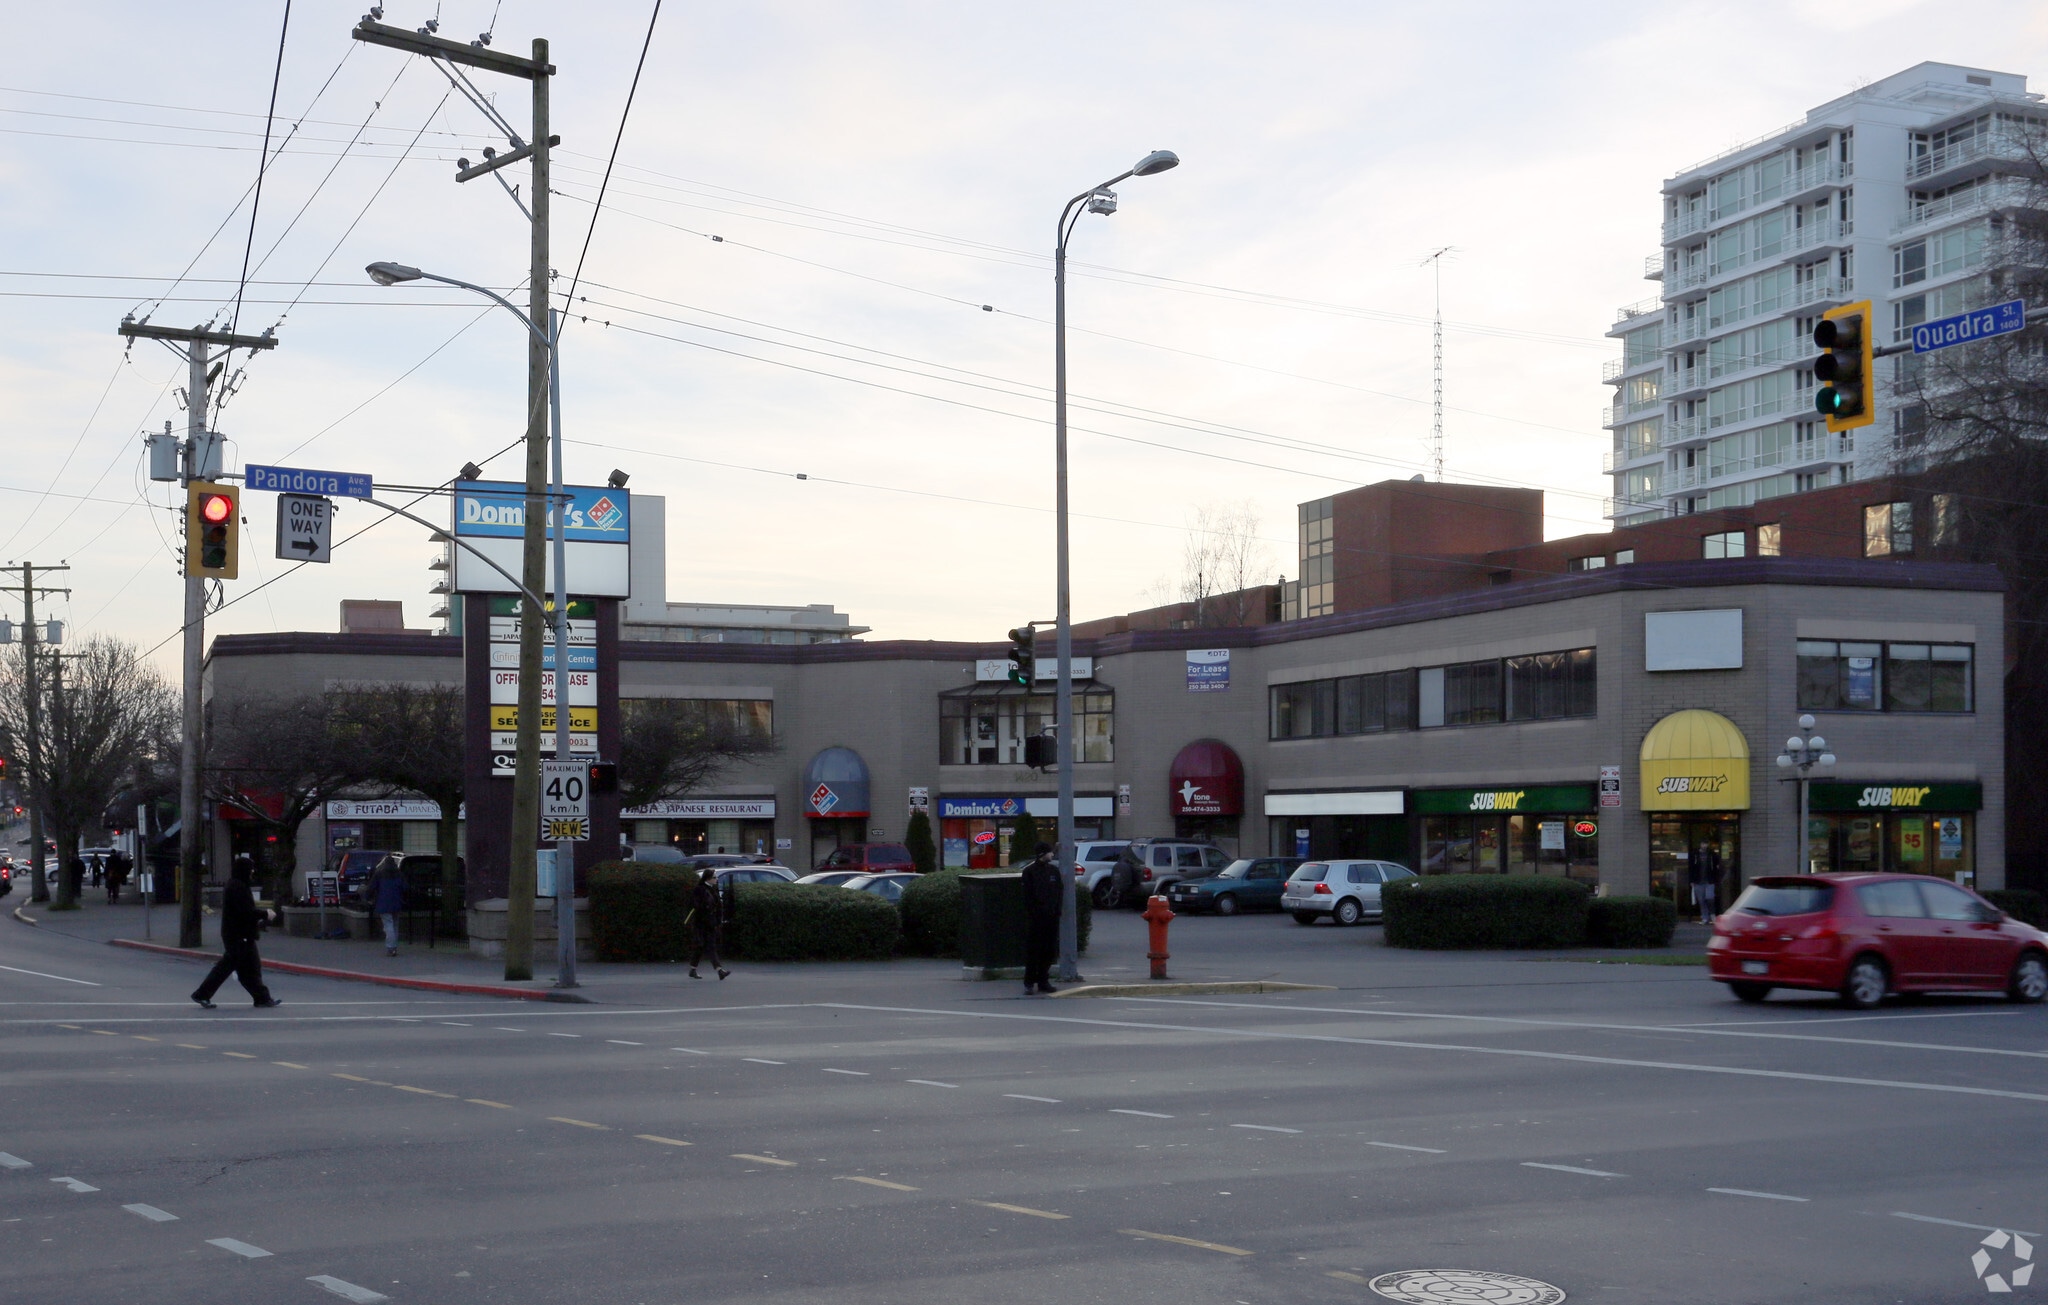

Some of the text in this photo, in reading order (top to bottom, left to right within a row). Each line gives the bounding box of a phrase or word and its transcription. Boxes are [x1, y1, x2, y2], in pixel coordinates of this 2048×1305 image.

[2000, 319, 2020, 331] 1400
[1916, 314, 1995, 350] Quadra
[254, 468, 368, 493] Pandora Ave.
[290, 501, 324, 518] ONE
[290, 518, 322, 534] WAY
[567, 654, 595, 664] Centre
[1187, 665, 1227, 673] For Lease
[546, 765, 584, 773] MAXIMUM
[545, 776, 584, 802] 40
[1657, 773, 1728, 795] SUBWAY
[1470, 789, 1525, 811] SUBWAY
[1857, 786, 1931, 807] SUBWAY
[355, 804, 399, 814] FUTABA
[550, 804, 580, 813] km/h
[666, 804, 706, 813] JAPANESE
[709, 804, 762, 813] RESTAURANT
[945, 802, 1001, 815] Domino's
[552, 823, 579, 834] NEW
[1576, 823, 1594, 833] OPEN
[976, 832, 996, 843] OPEN
[1904, 833, 1921, 848] $5
